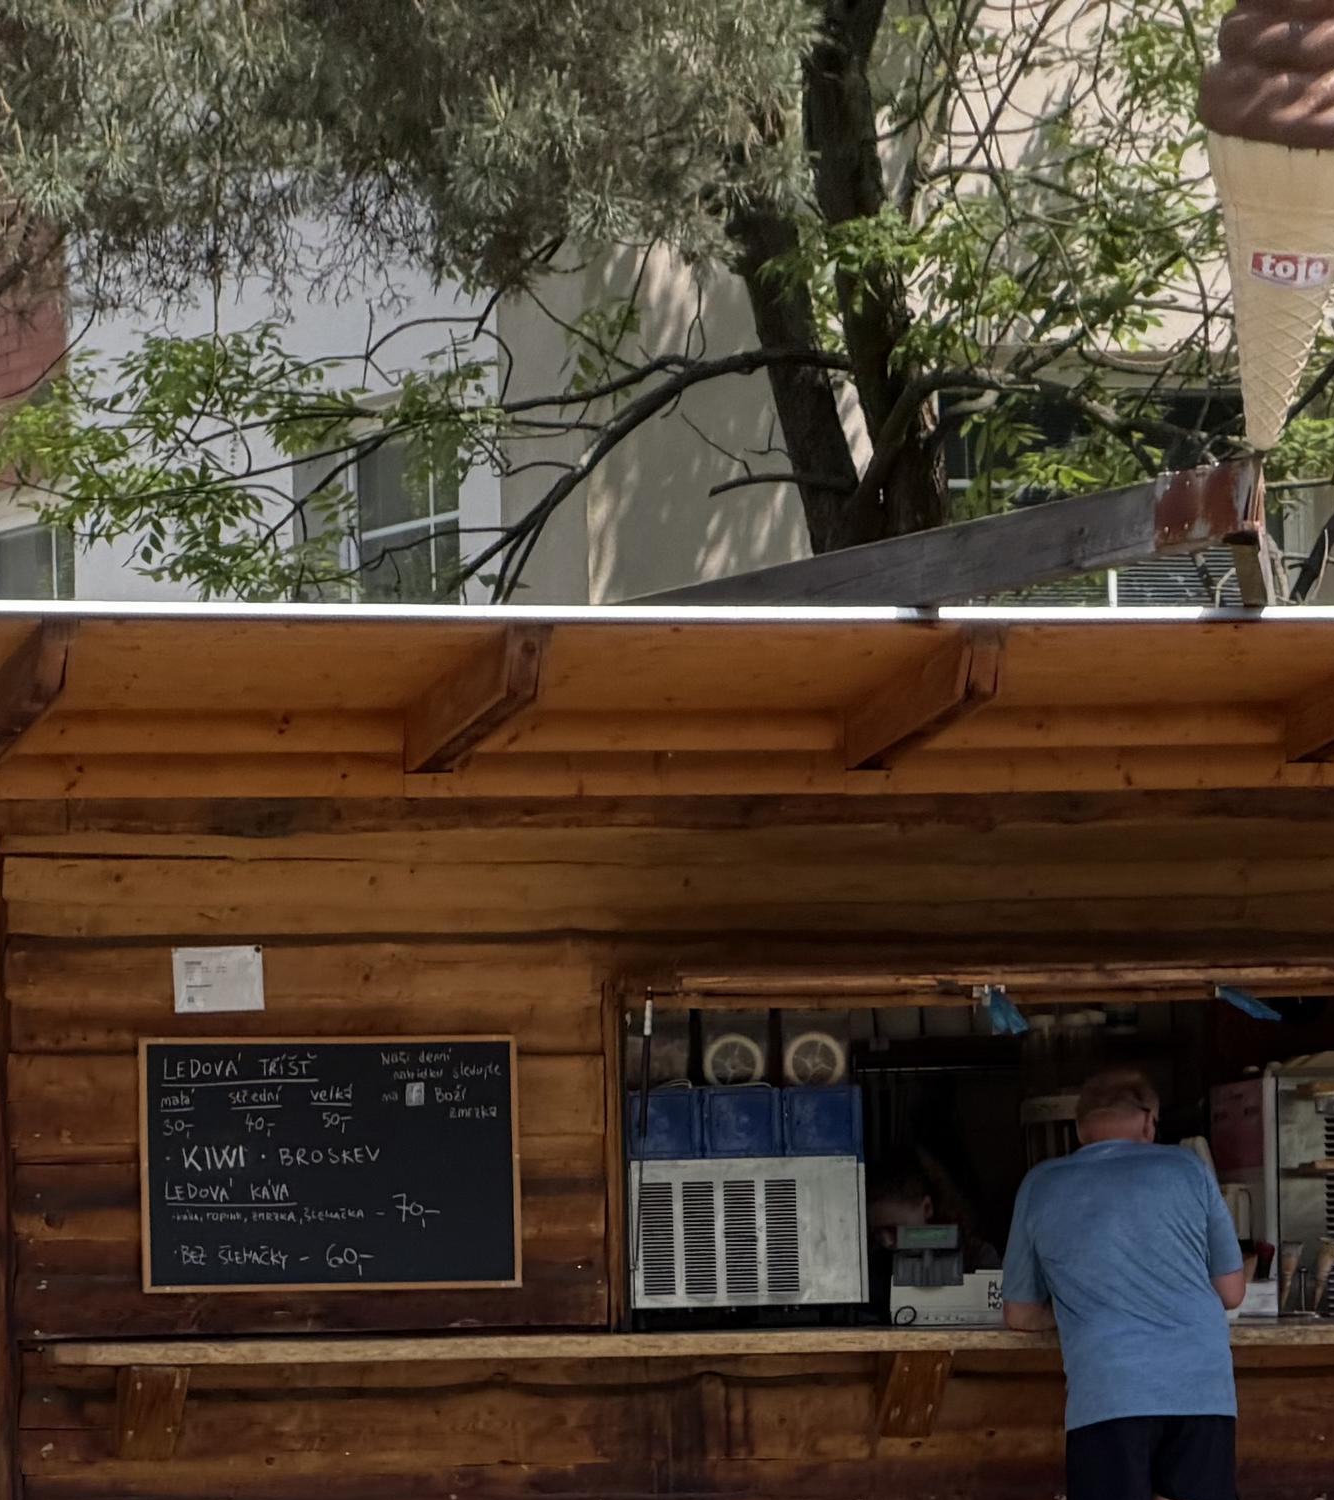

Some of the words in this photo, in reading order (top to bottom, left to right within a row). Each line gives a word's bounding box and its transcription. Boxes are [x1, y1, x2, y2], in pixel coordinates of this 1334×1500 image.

[162, 1052, 242, 1080] LEDOVÁ
[258, 1052, 317, 1077] TŘÍŠŤ
[310, 1083, 353, 1101] velká
[182, 1144, 246, 1172] KIWI
[279, 1145, 380, 1167] BROSKEV
[164, 1178, 234, 1203] LEDOVÁ
[250, 1179, 290, 1201] KÁVA
[218, 1245, 289, 1271] ŠLEHAČKY
